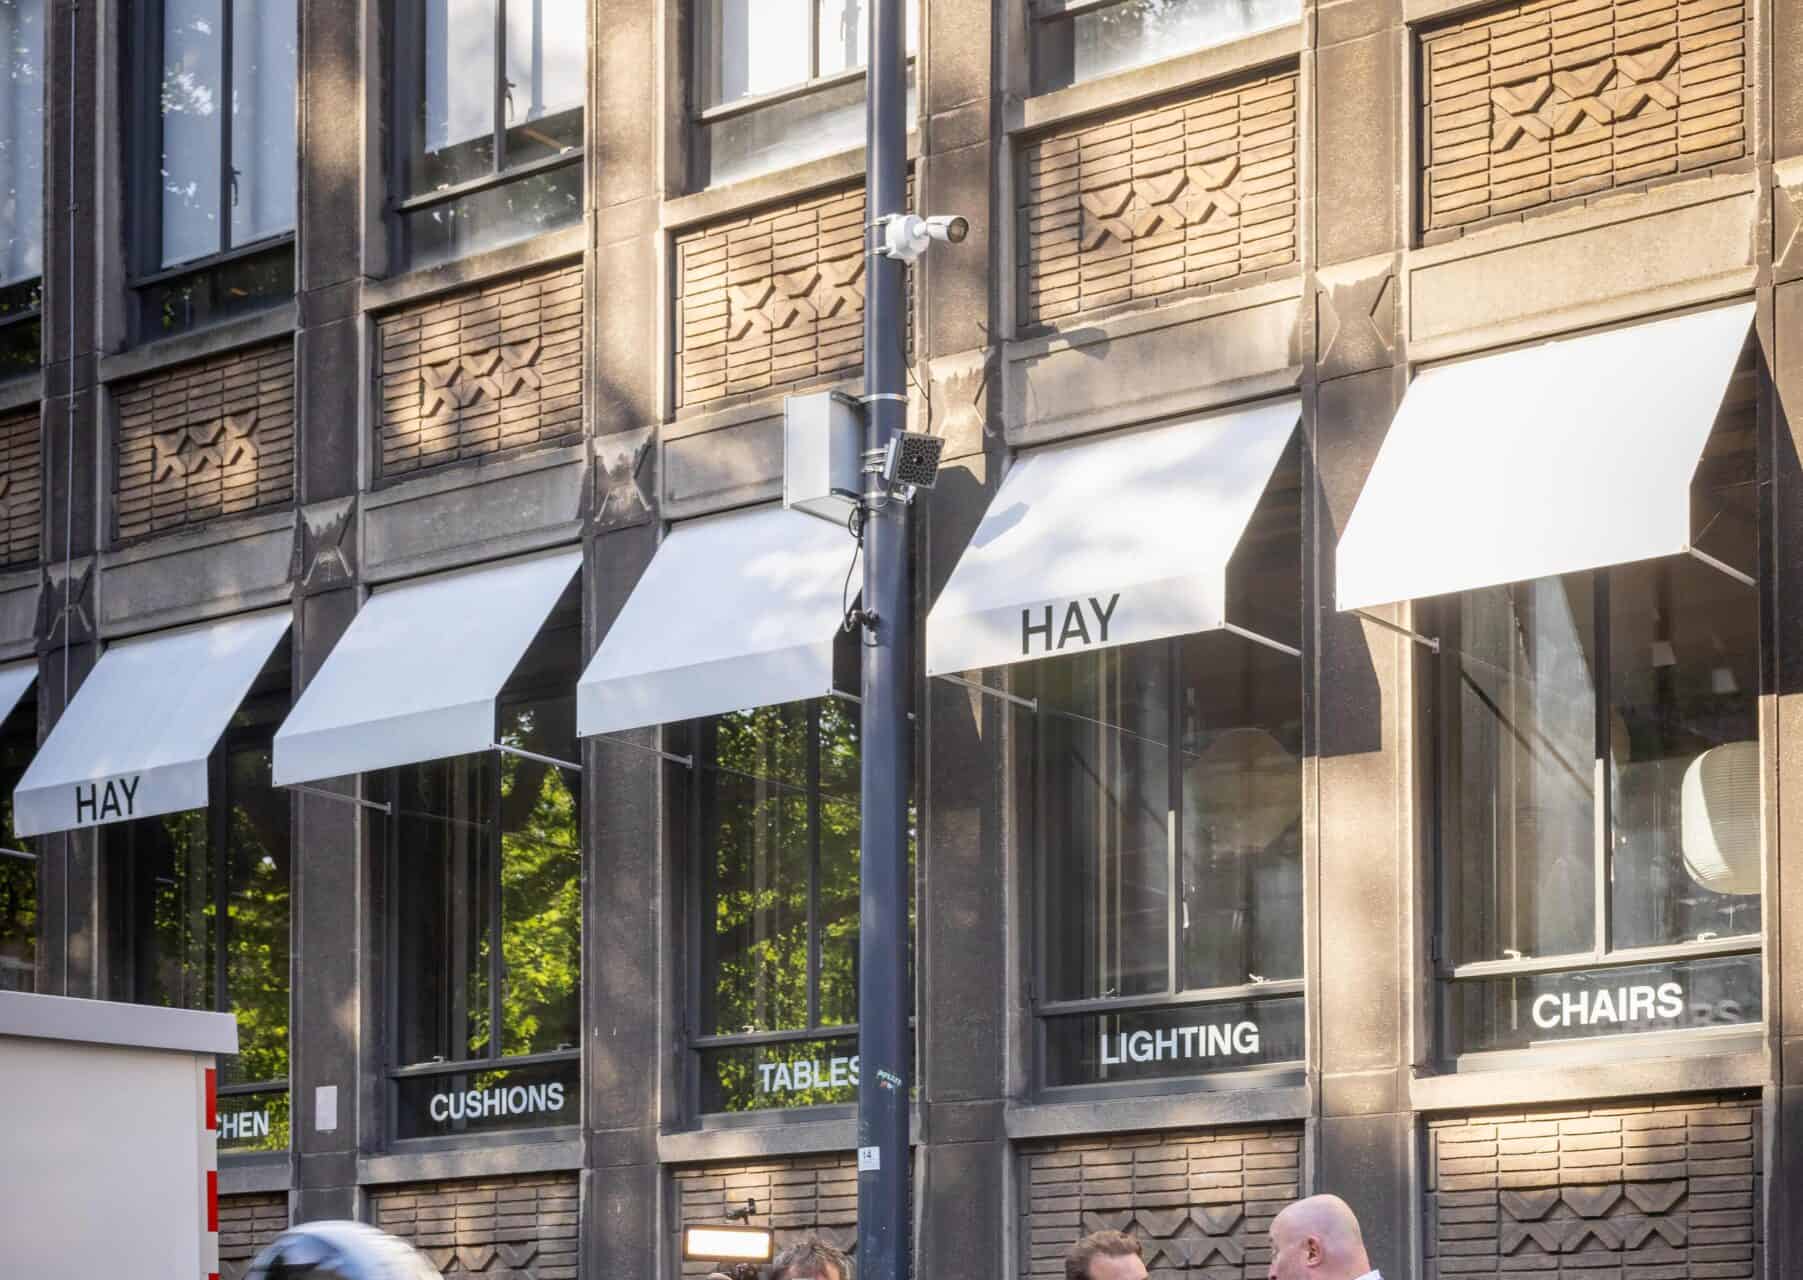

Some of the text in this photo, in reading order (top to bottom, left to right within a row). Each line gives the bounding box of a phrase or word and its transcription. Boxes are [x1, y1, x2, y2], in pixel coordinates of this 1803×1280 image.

[1022, 593, 1120, 655] HAY
[76, 775, 140, 824] HAY
[1532, 982, 1684, 1029] CHAIRS
[1101, 1021, 1260, 1065] LIGHTING
[430, 1082, 564, 1122] CUSHIONS
